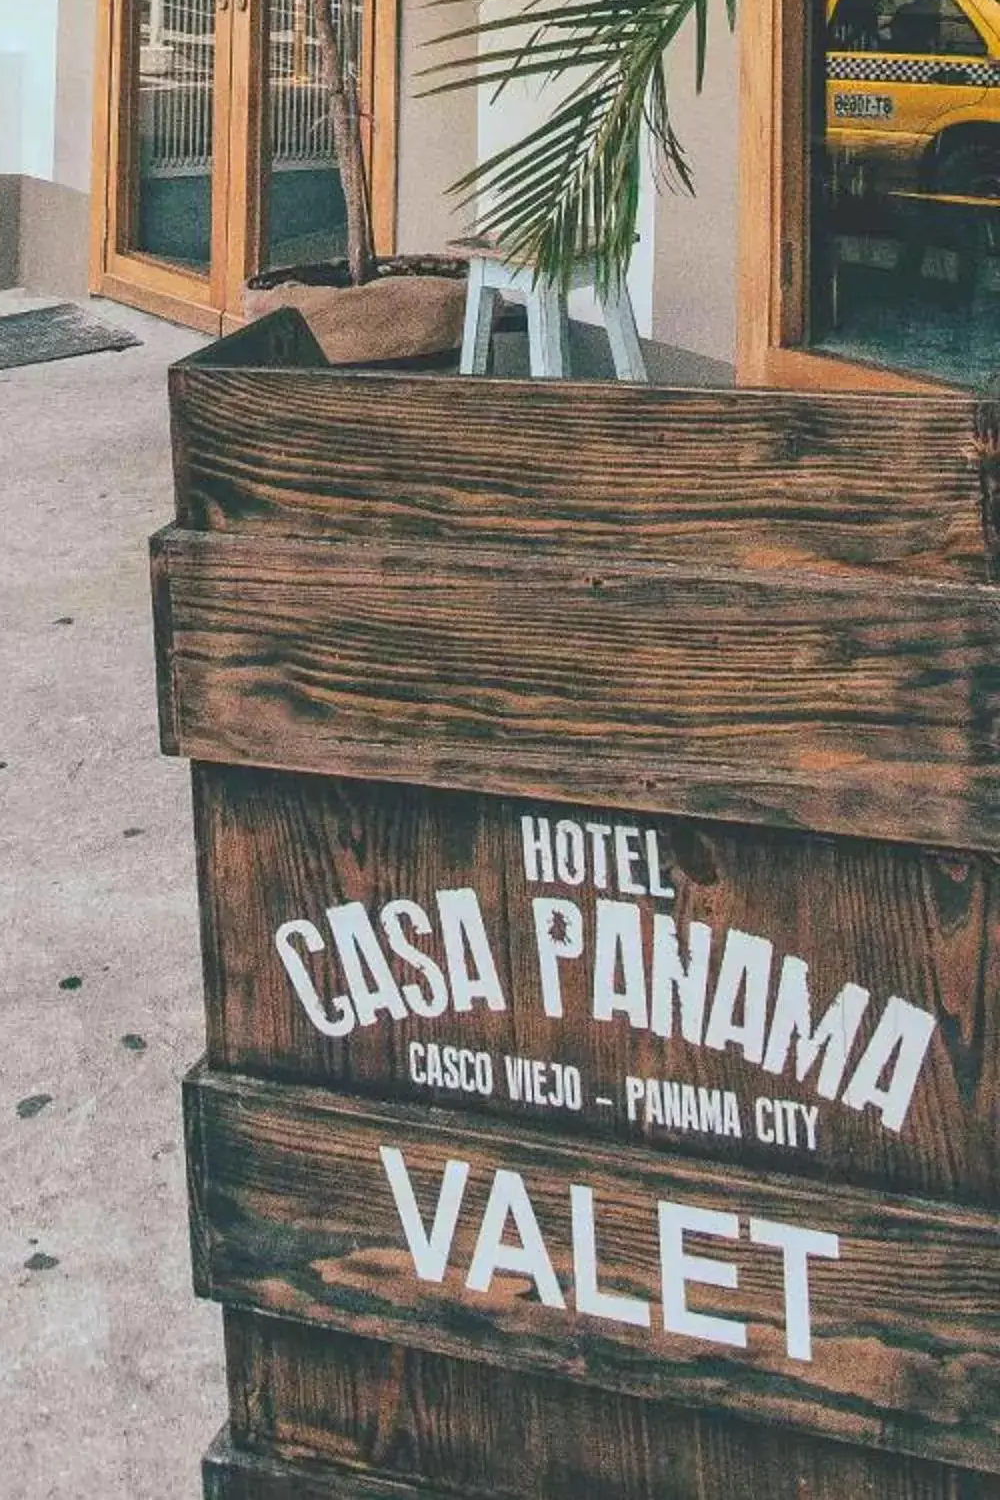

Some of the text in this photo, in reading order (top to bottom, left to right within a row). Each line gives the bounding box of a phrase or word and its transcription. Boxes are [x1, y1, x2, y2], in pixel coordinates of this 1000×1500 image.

[521, 815, 676, 898] HOTEL
[275, 887, 938, 1133] CASA PANAMA
[408, 1041, 494, 1096] CASCO
[504, 1054, 583, 1111] VIEJO
[625, 1075, 742, 1139] PANAMA
[755, 1097, 820, 1151] CITY
[378, 1145, 841, 1363] VALET
